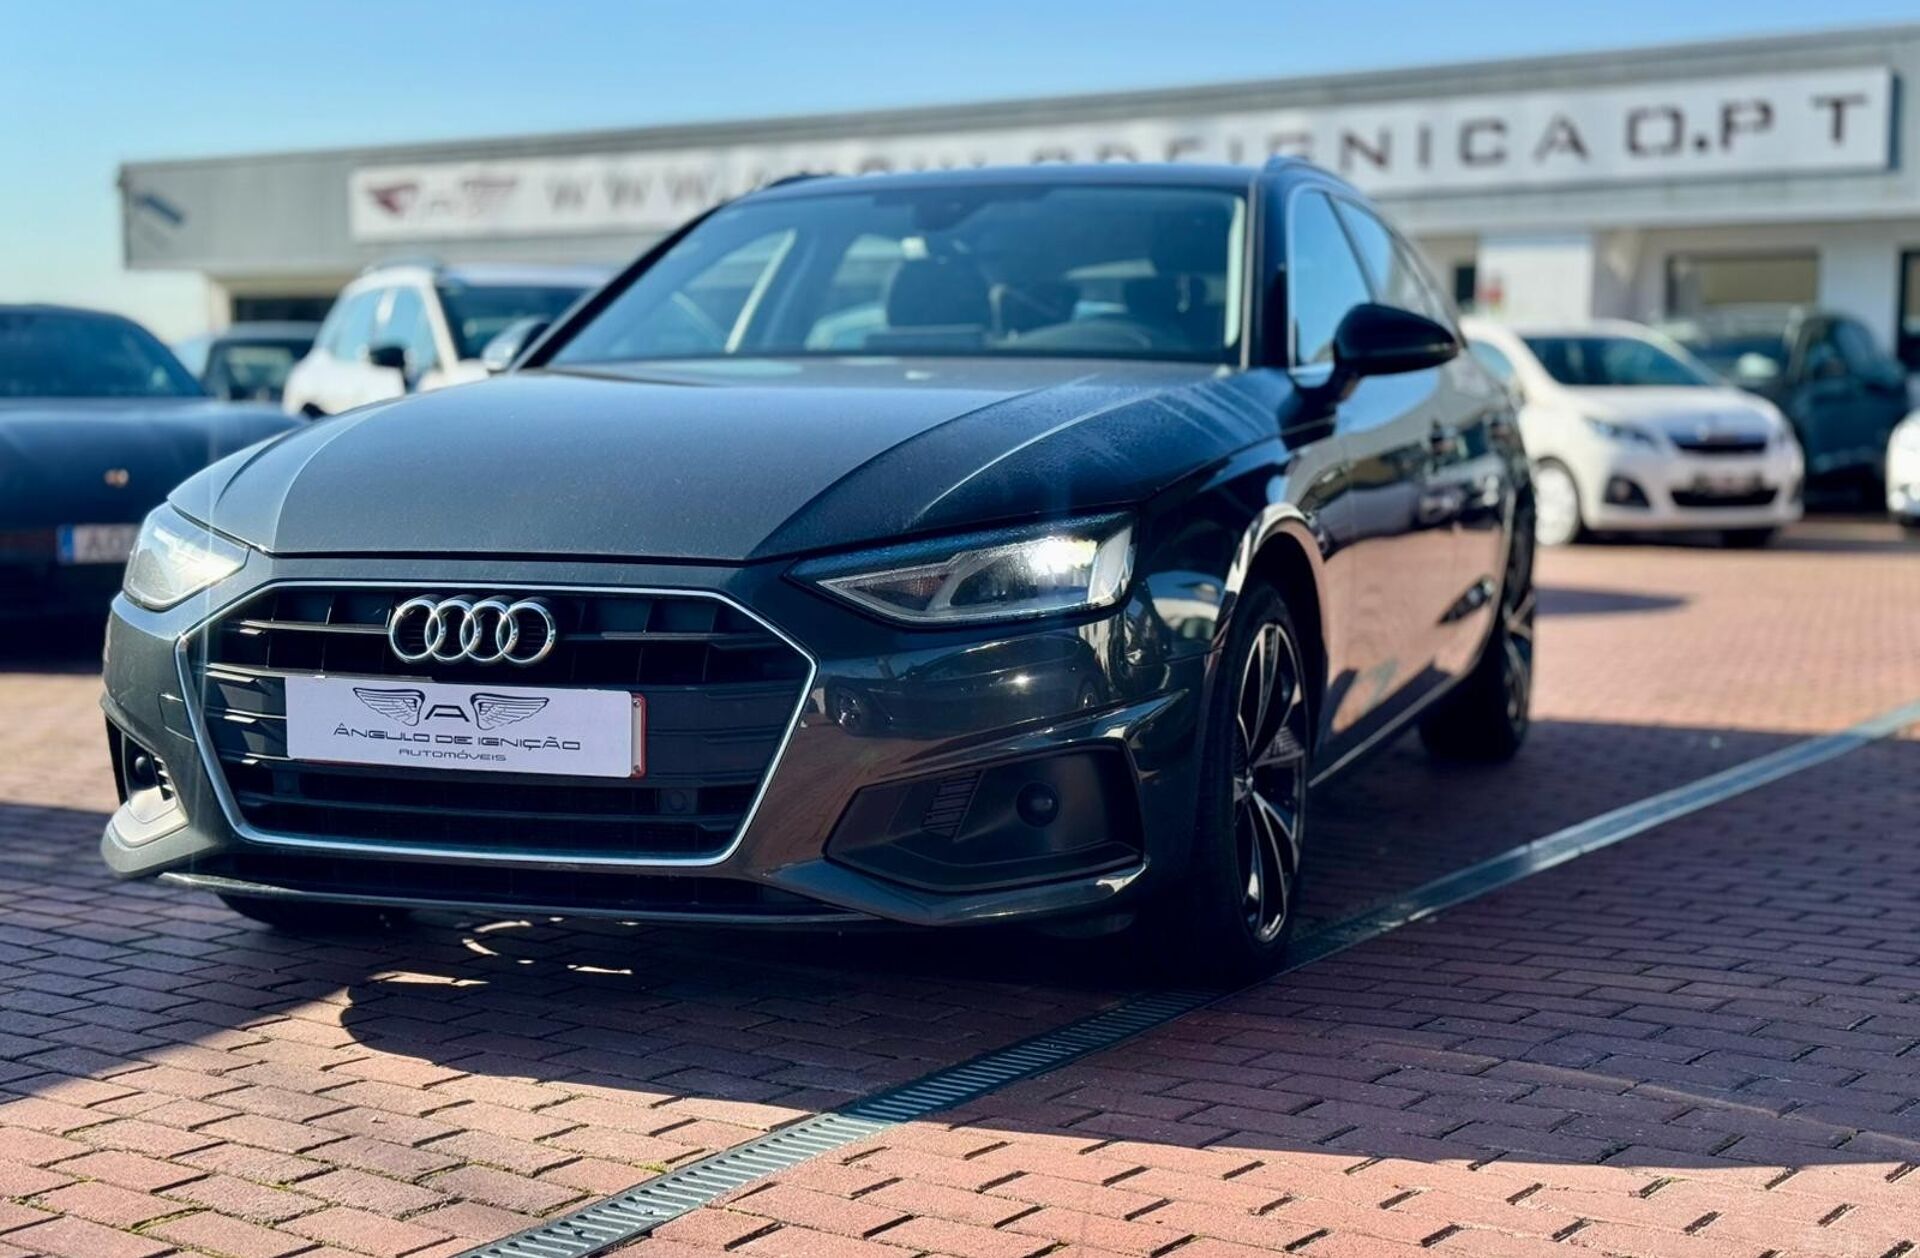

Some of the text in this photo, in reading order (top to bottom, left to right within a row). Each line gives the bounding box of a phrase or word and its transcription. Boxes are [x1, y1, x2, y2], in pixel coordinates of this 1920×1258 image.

[333, 722, 580, 751] ÂNGULO DE IGNIÇÃO
